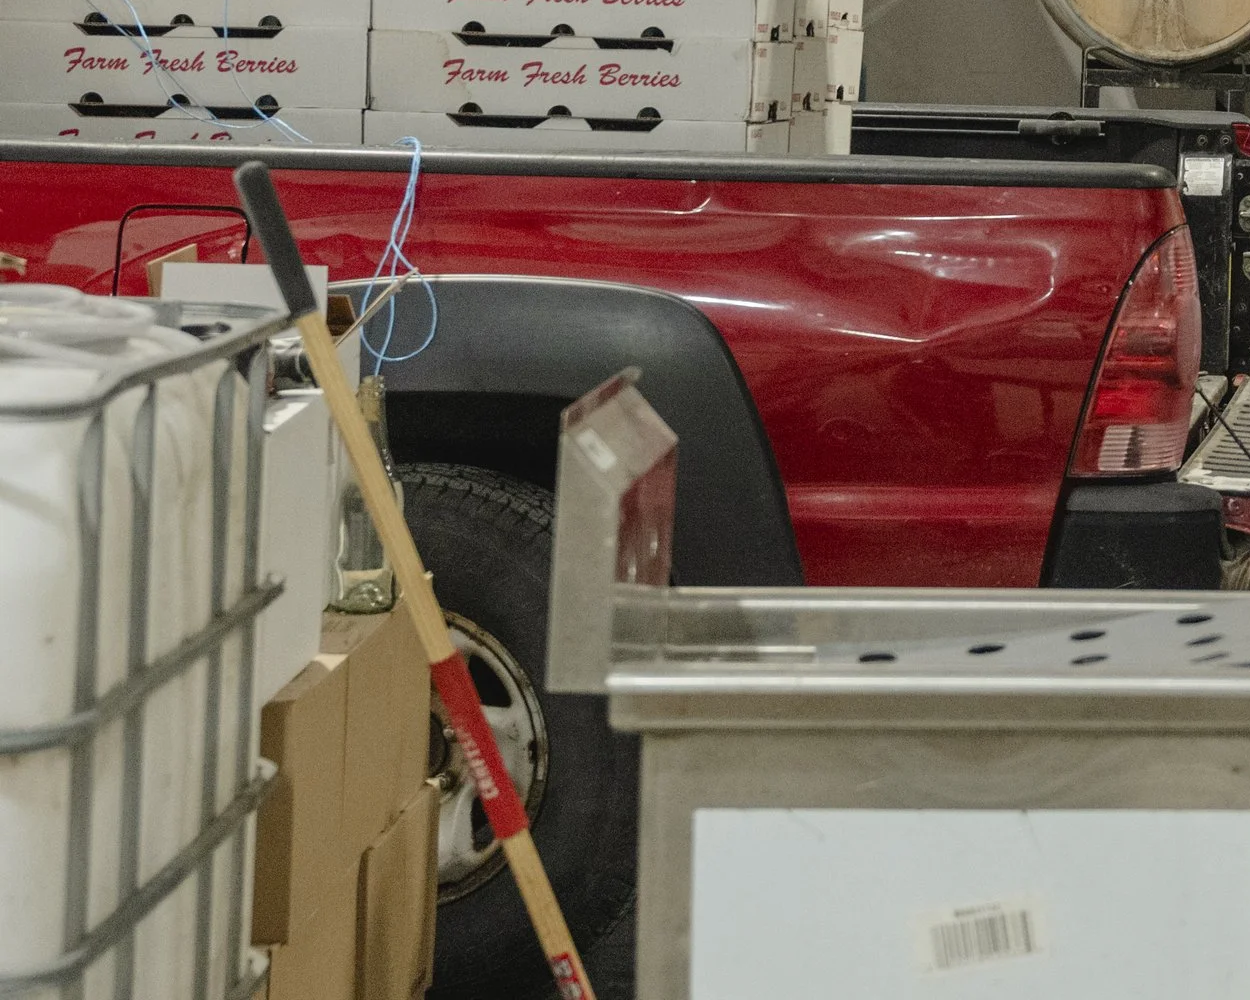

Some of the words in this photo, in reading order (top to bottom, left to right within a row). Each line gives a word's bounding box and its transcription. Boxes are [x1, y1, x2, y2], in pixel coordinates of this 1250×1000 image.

[63, 46, 130, 74] Farm
[140, 49, 206, 76] Fresh
[215, 50, 298, 75] Berries
[442, 58, 510, 85] Farm
[521, 61, 588, 88] Fresh
[598, 63, 682, 89] Berries
